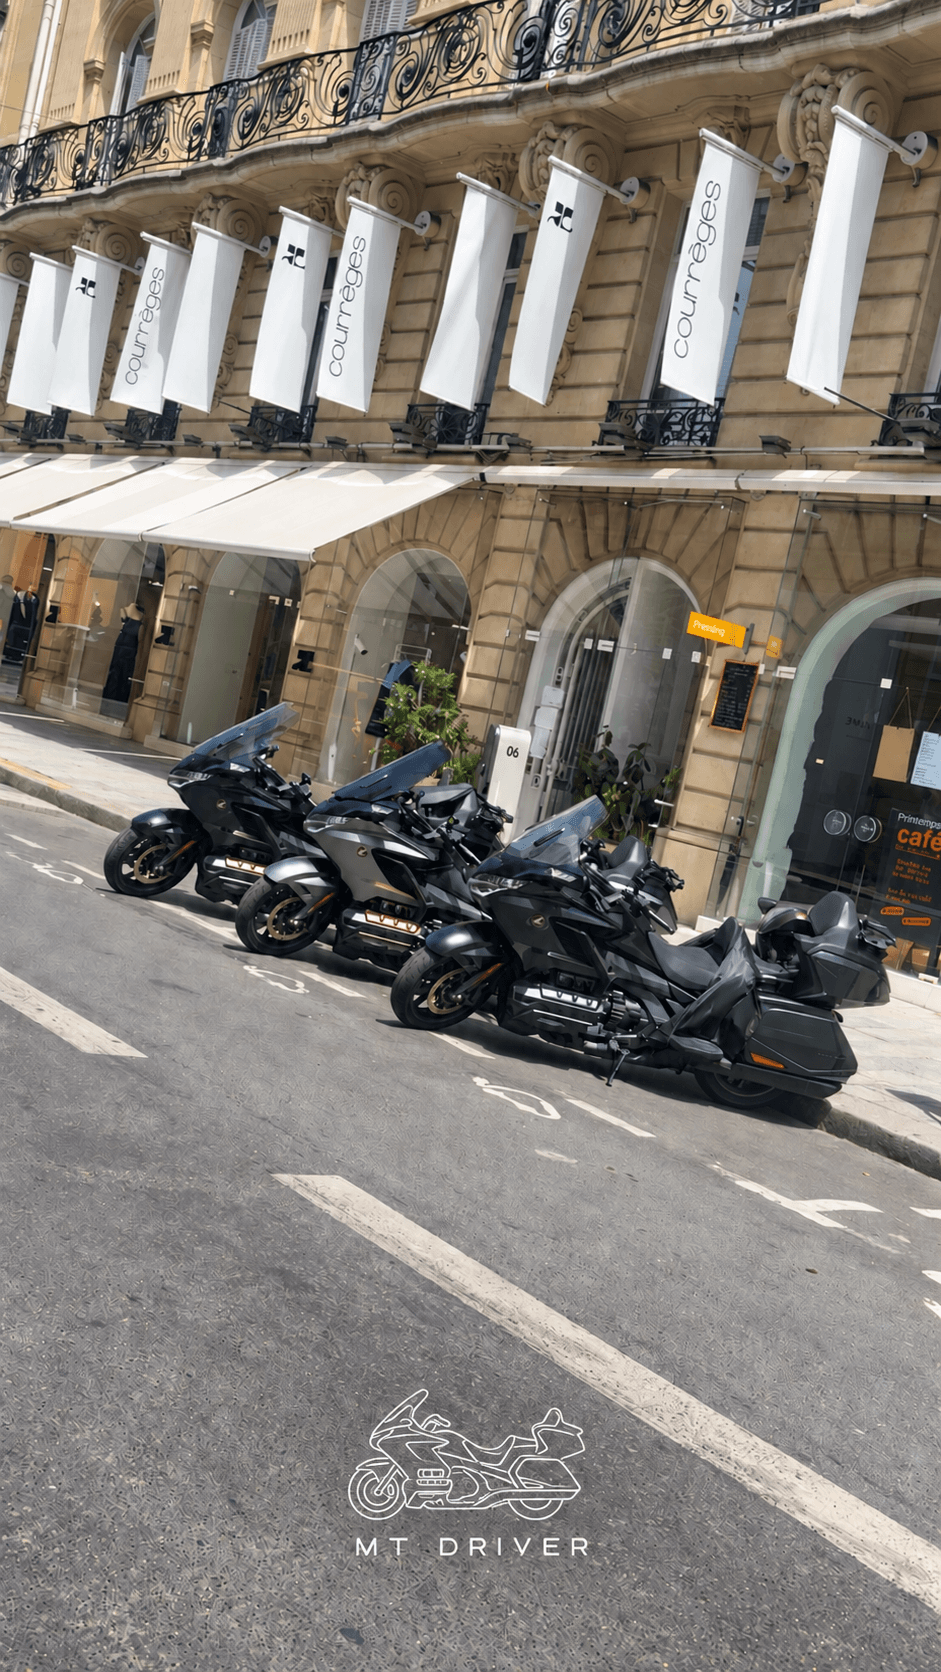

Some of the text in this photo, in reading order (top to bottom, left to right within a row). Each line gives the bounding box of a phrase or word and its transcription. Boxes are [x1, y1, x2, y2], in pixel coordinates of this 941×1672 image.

[125, 267, 165, 385] courrèges
[329, 235, 367, 377] courrèges
[674, 180, 721, 359] courrèges
[506, 745, 519, 759] 06
